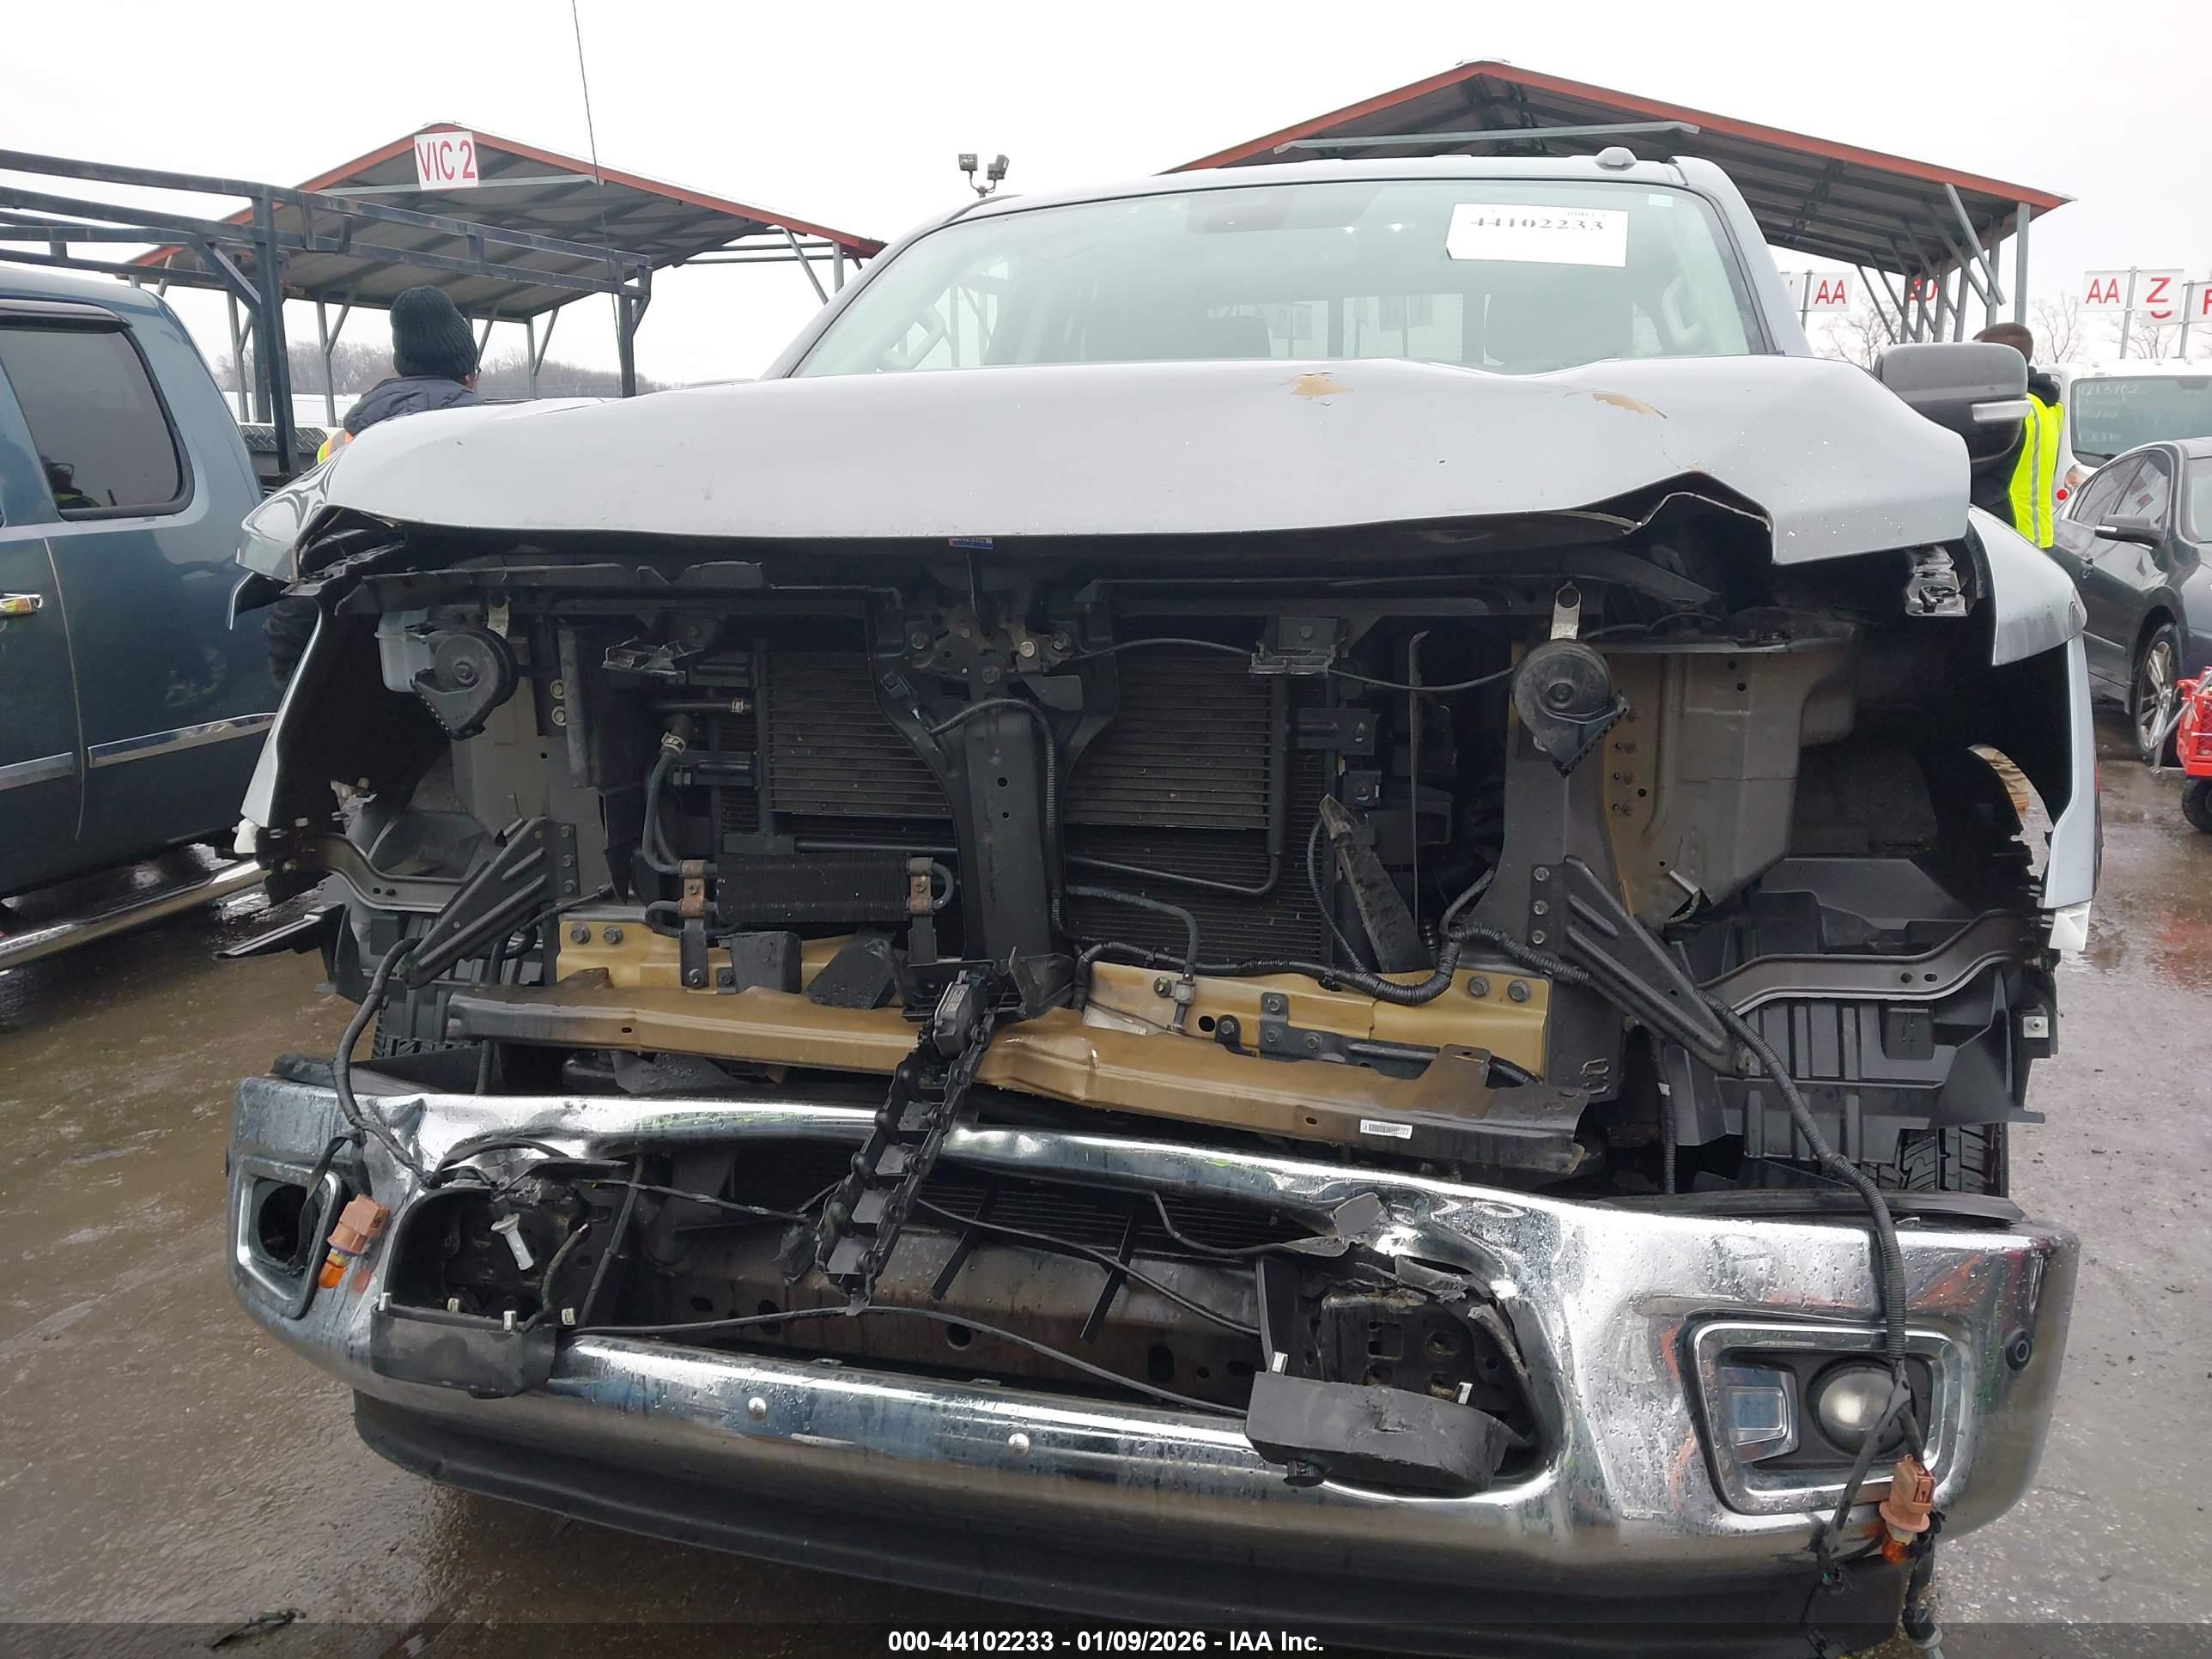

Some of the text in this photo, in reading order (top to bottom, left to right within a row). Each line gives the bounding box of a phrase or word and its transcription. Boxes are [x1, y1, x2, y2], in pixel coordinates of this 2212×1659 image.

[416, 138, 476, 181] VIC 2
[1469, 216, 1605, 232] 44102233
[1814, 279, 1847, 305] AA
[2085, 277, 2120, 304] AA
[2145, 276, 2172, 303] Z
